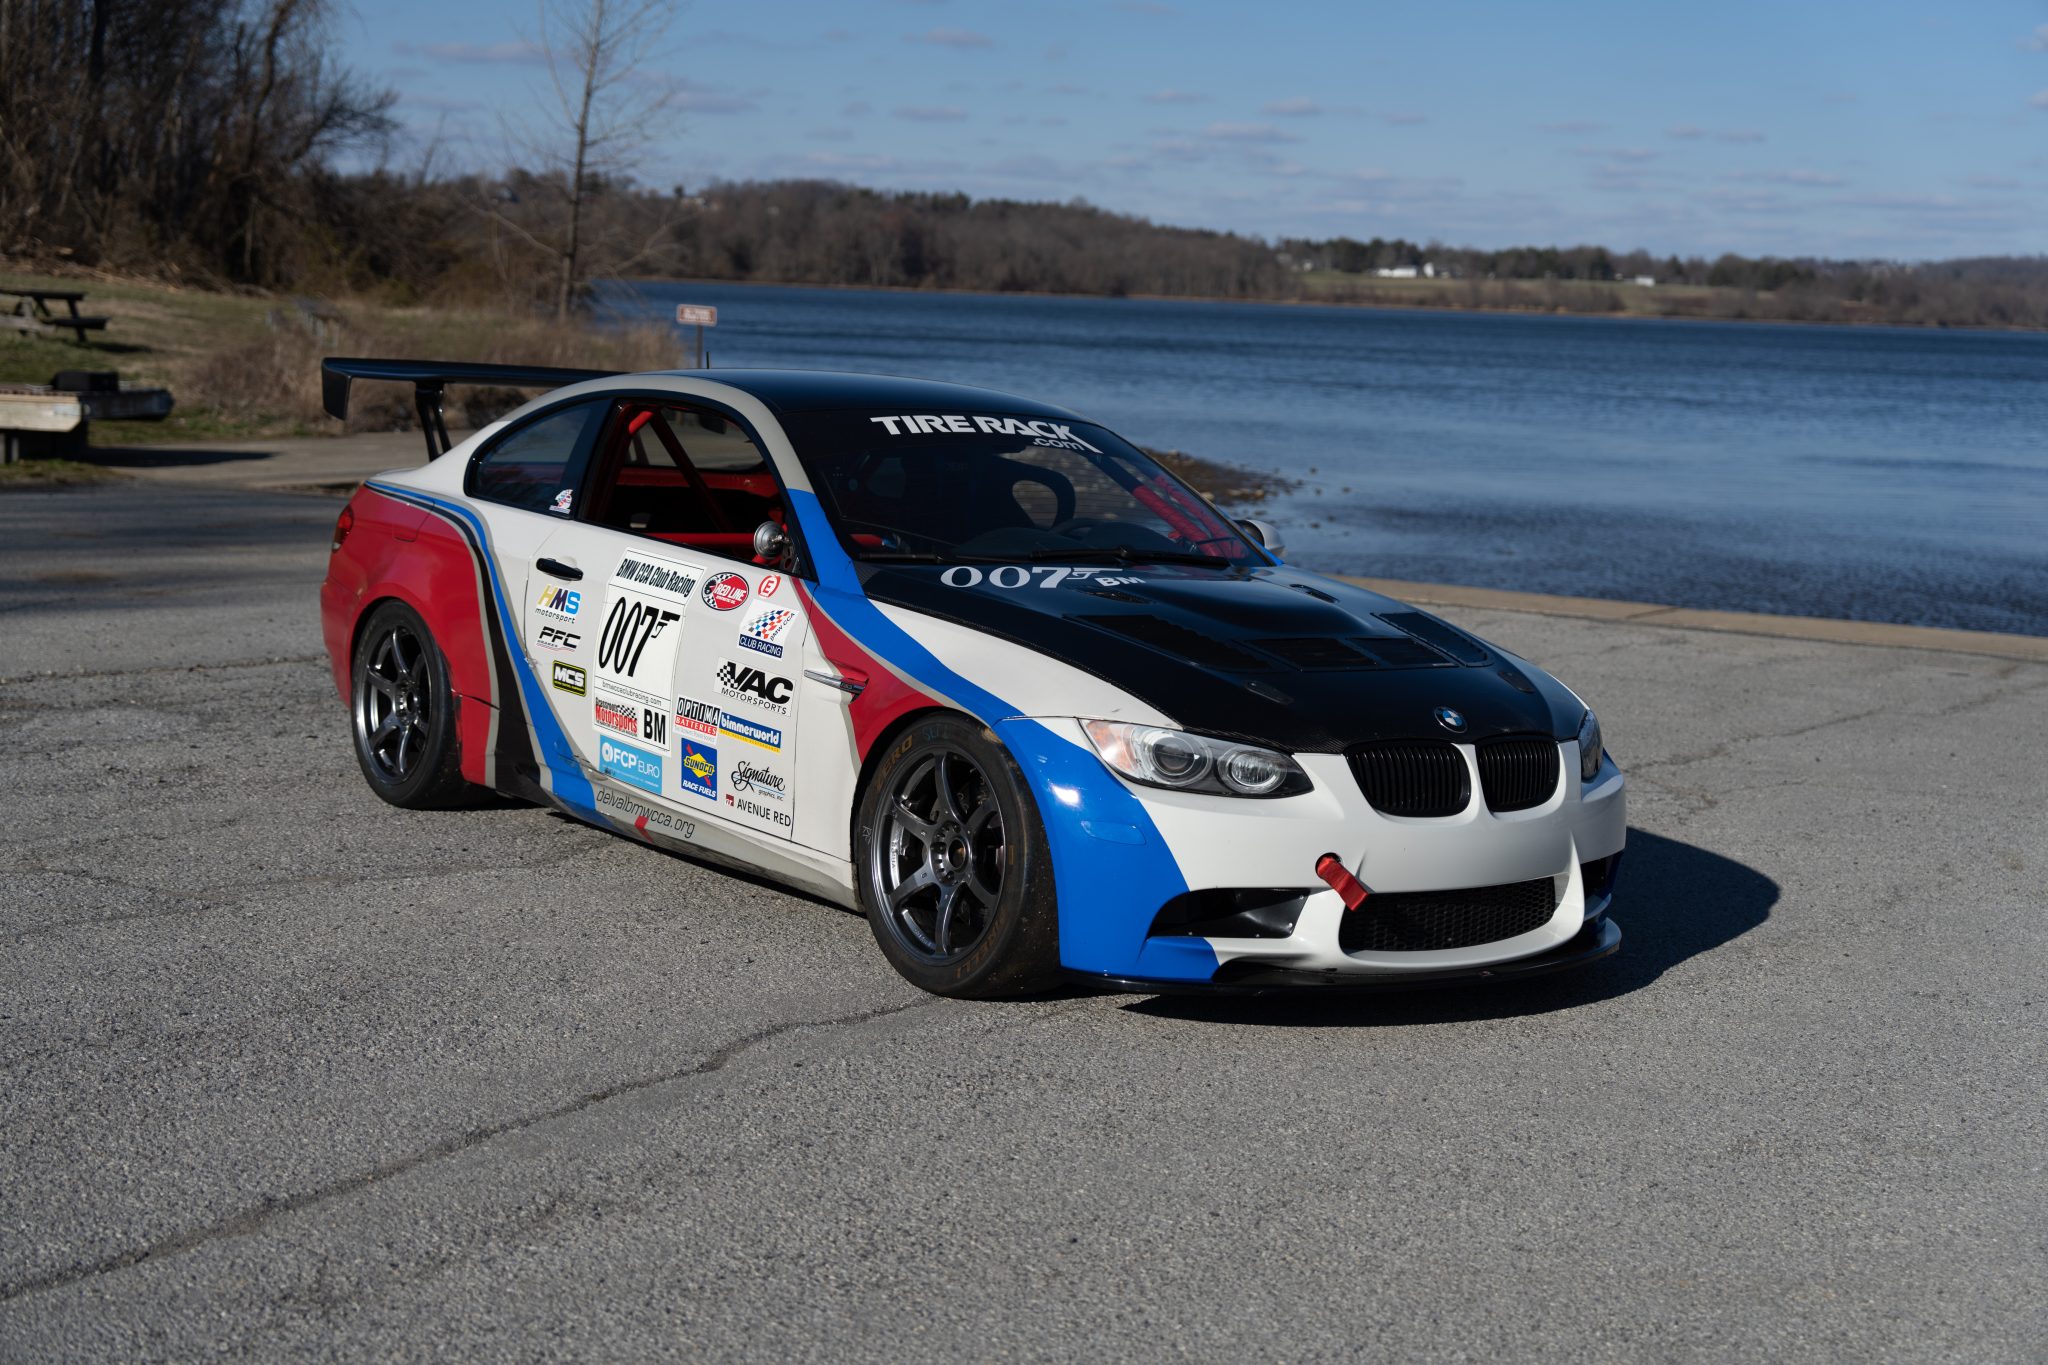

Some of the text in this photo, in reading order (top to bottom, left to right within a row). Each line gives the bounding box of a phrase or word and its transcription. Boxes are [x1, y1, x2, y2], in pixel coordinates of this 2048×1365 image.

[870, 415, 1104, 454] TIRE RACK
[1033, 437, 1085, 451] .com
[616, 558, 696, 597] BMW CCA Club Racing
[713, 583, 747, 601] RED LINE
[940, 566, 1073, 589] 007
[1094, 577, 1147, 587] BM
[537, 584, 581, 615] HMS
[535, 608, 576, 624] motorsport
[769, 612, 796, 642] BMW CCA
[539, 626, 581, 649] PFC
[599, 597, 660, 677] 007
[740, 637, 782, 656] CLUB RACING
[554, 665, 585, 688] MCS
[717, 661, 794, 705] VAC
[677, 697, 720, 726] OPTIMA
[721, 687, 787, 715] MOTORSPORTS
[596, 704, 638, 733] Motorsports
[644, 708, 666, 745] BM
[675, 716, 717, 735] BATTERIES
[721, 714, 780, 745] bimmerworld
[613, 748, 638, 769] FCP
[638, 760, 660, 779] EURO
[684, 757, 714, 775] SUNOCO
[731, 761, 786, 792] Signature
[682, 779, 717, 798] RACE FUELS
[596, 785, 696, 839] delvalbmwcca.org
[737, 798, 771, 820] AVENUE
[773, 811, 791, 827] RED
